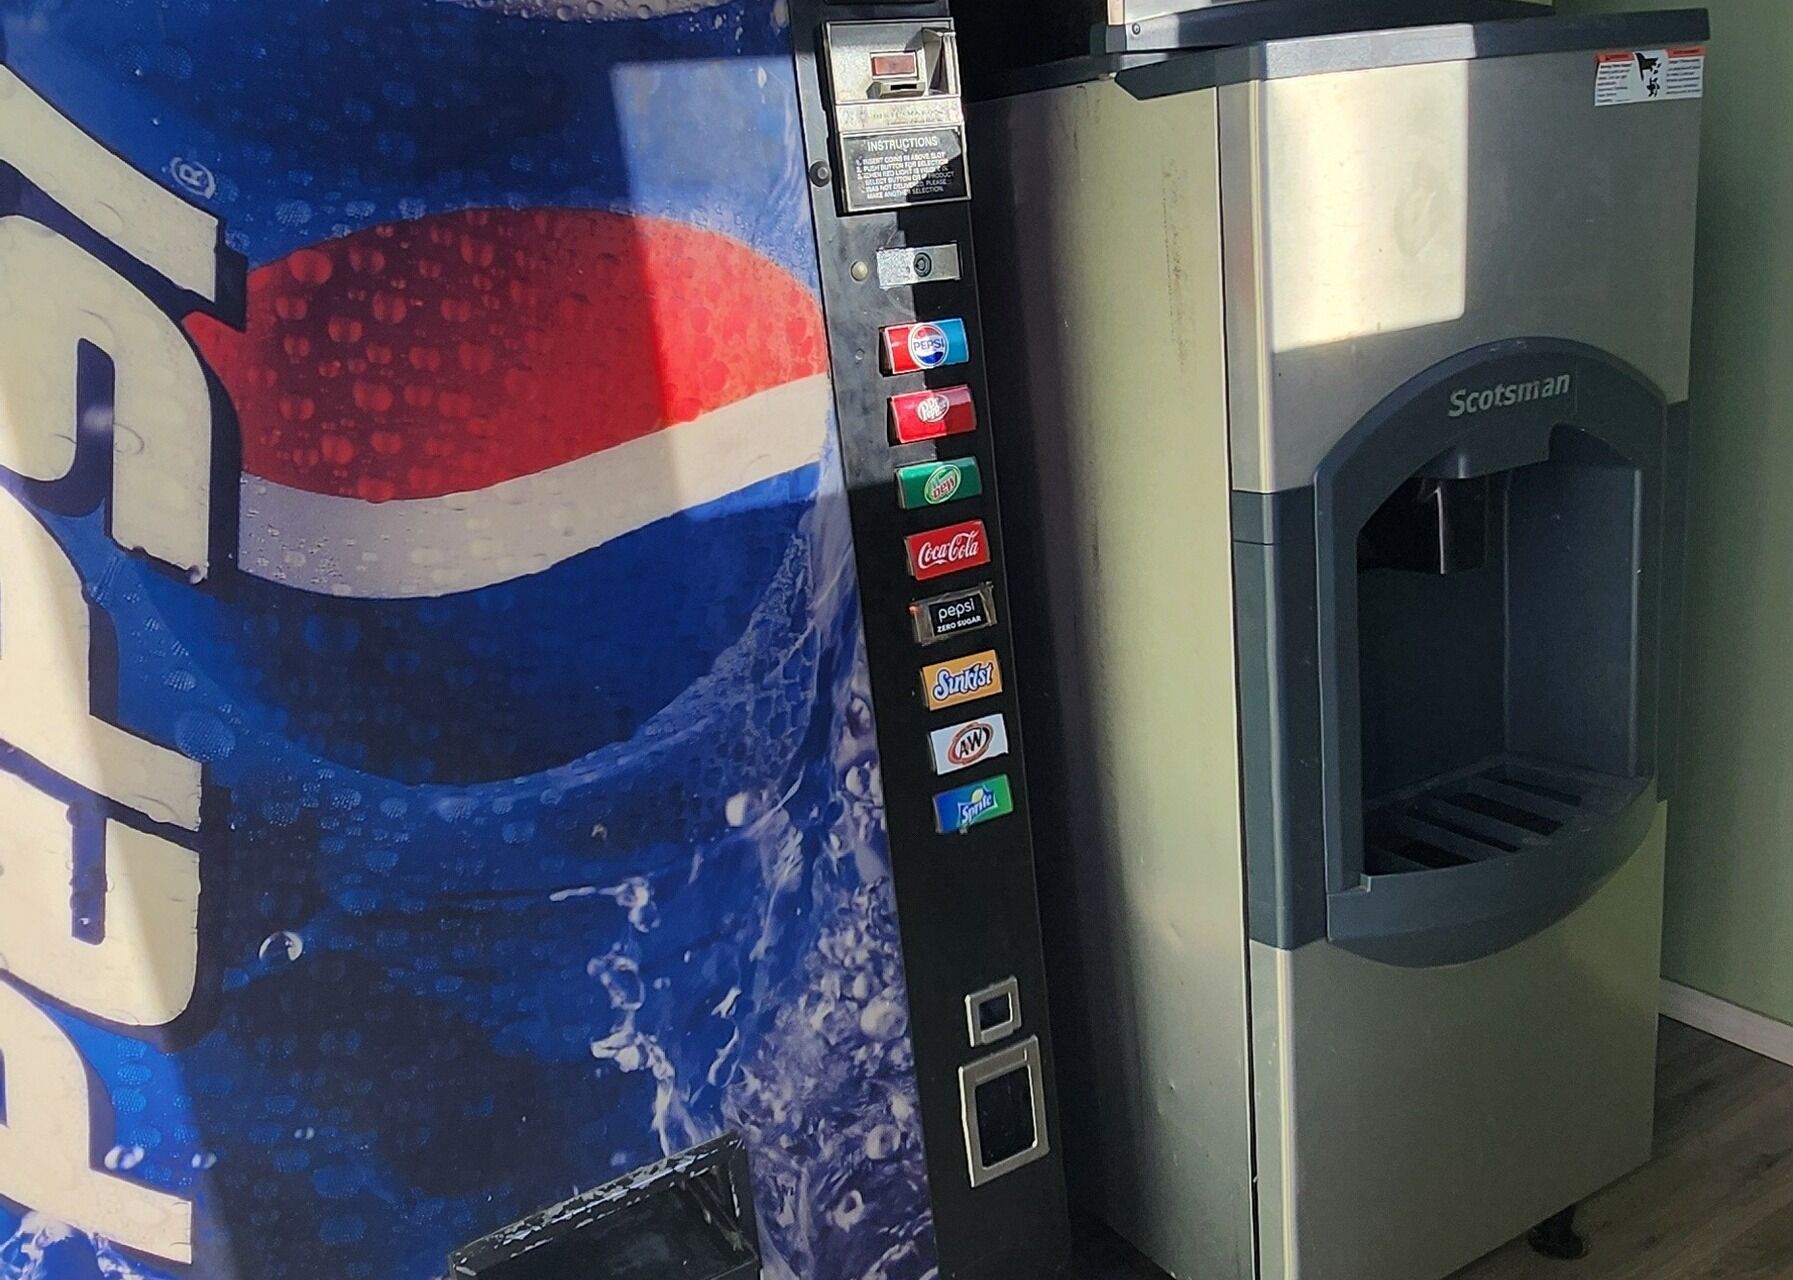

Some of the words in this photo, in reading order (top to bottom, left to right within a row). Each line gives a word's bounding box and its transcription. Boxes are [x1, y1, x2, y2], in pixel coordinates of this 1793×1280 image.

[867, 136, 939, 152] INSTRUCTIONS
[911, 153, 930, 161] ABOVE
[880, 162, 904, 171] BUTTON
[887, 175, 911, 184] BUTTON
[928, 171, 955, 179] PRODUCT
[913, 337, 945, 351] PEPSI
[1448, 374, 1570, 417] Scotsman
[938, 597, 975, 623] pepsi
[936, 622, 957, 633] ZERO
[957, 615, 982, 627] SUGAR
[933, 662, 994, 701] Sunkist
[961, 793, 993, 825] Sprite
